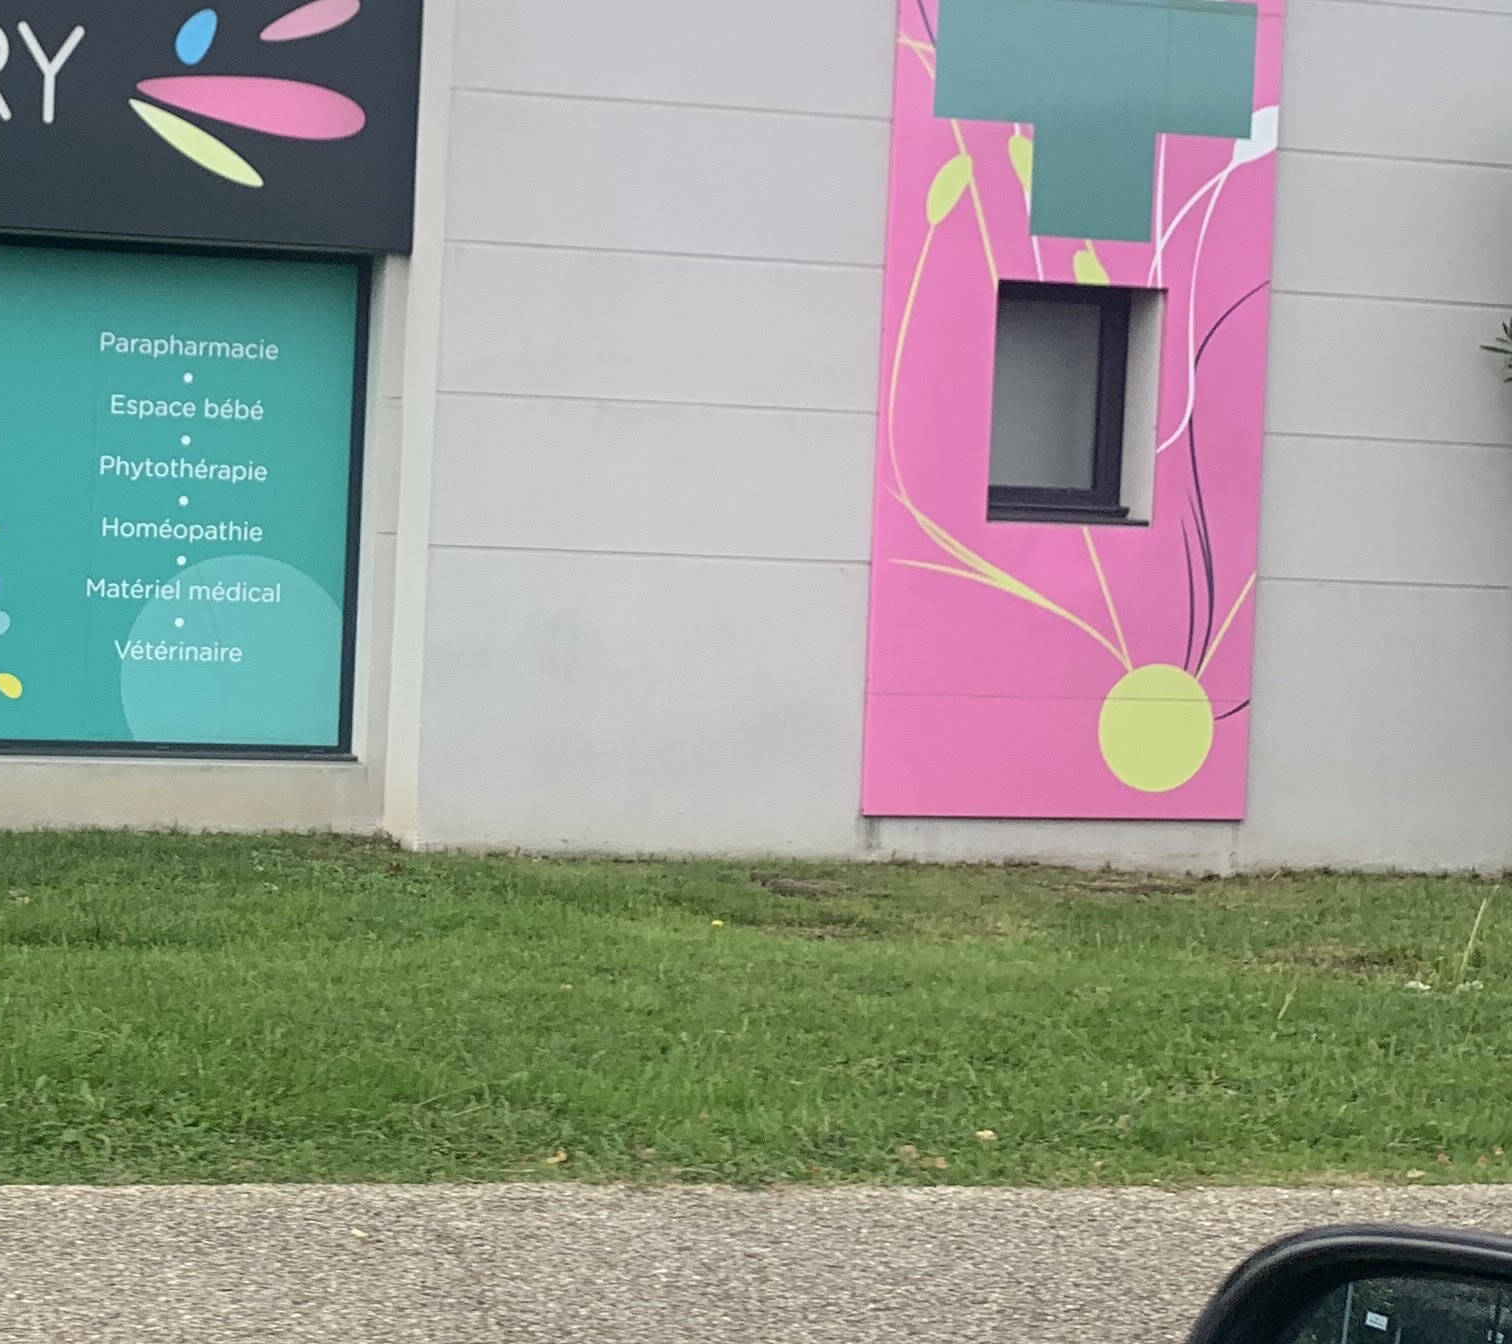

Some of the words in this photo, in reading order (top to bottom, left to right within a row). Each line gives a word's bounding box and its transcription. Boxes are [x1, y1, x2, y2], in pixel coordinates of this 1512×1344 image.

[99, 331, 280, 360] Parapharmacie
[110, 394, 196, 419] Espace
[203, 398, 264, 420] bébé
[99, 455, 269, 484] Phytothérapie
[101, 517, 264, 543] Homéopathie
[86, 577, 181, 600] Matériel
[188, 582, 282, 603] médical
[114, 639, 243, 662] Vétérinaire
